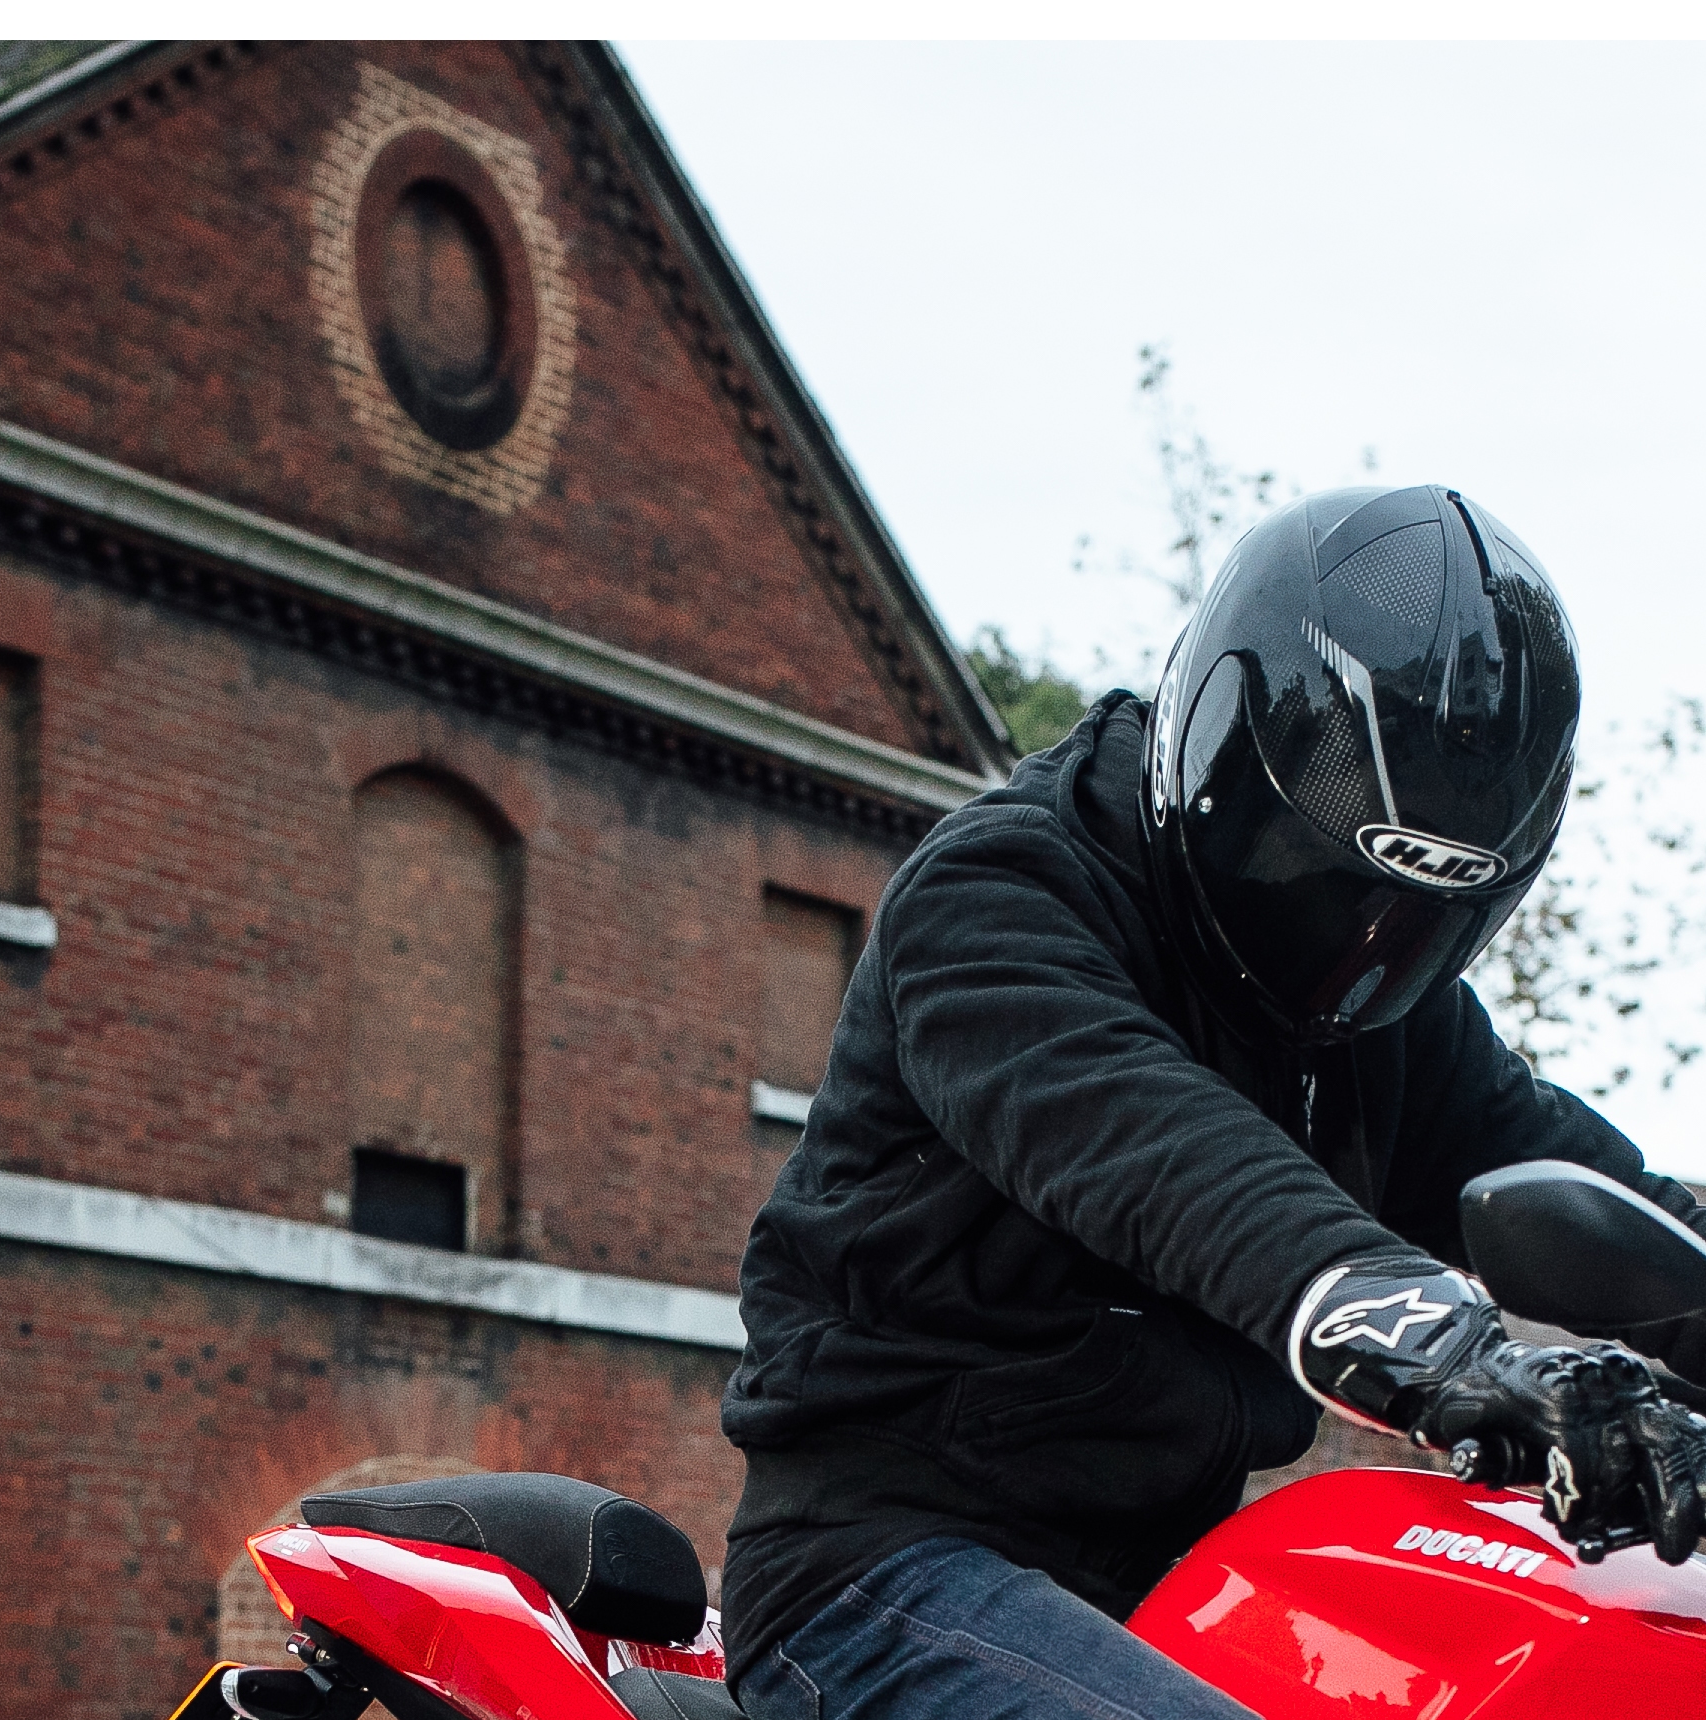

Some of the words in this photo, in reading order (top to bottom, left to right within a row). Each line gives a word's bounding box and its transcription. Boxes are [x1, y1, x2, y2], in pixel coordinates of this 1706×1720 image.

[1379, 837, 1494, 882] HJC
[277, 1533, 312, 1553] DUCATI
[1394, 1525, 1547, 1578] DUCATI
